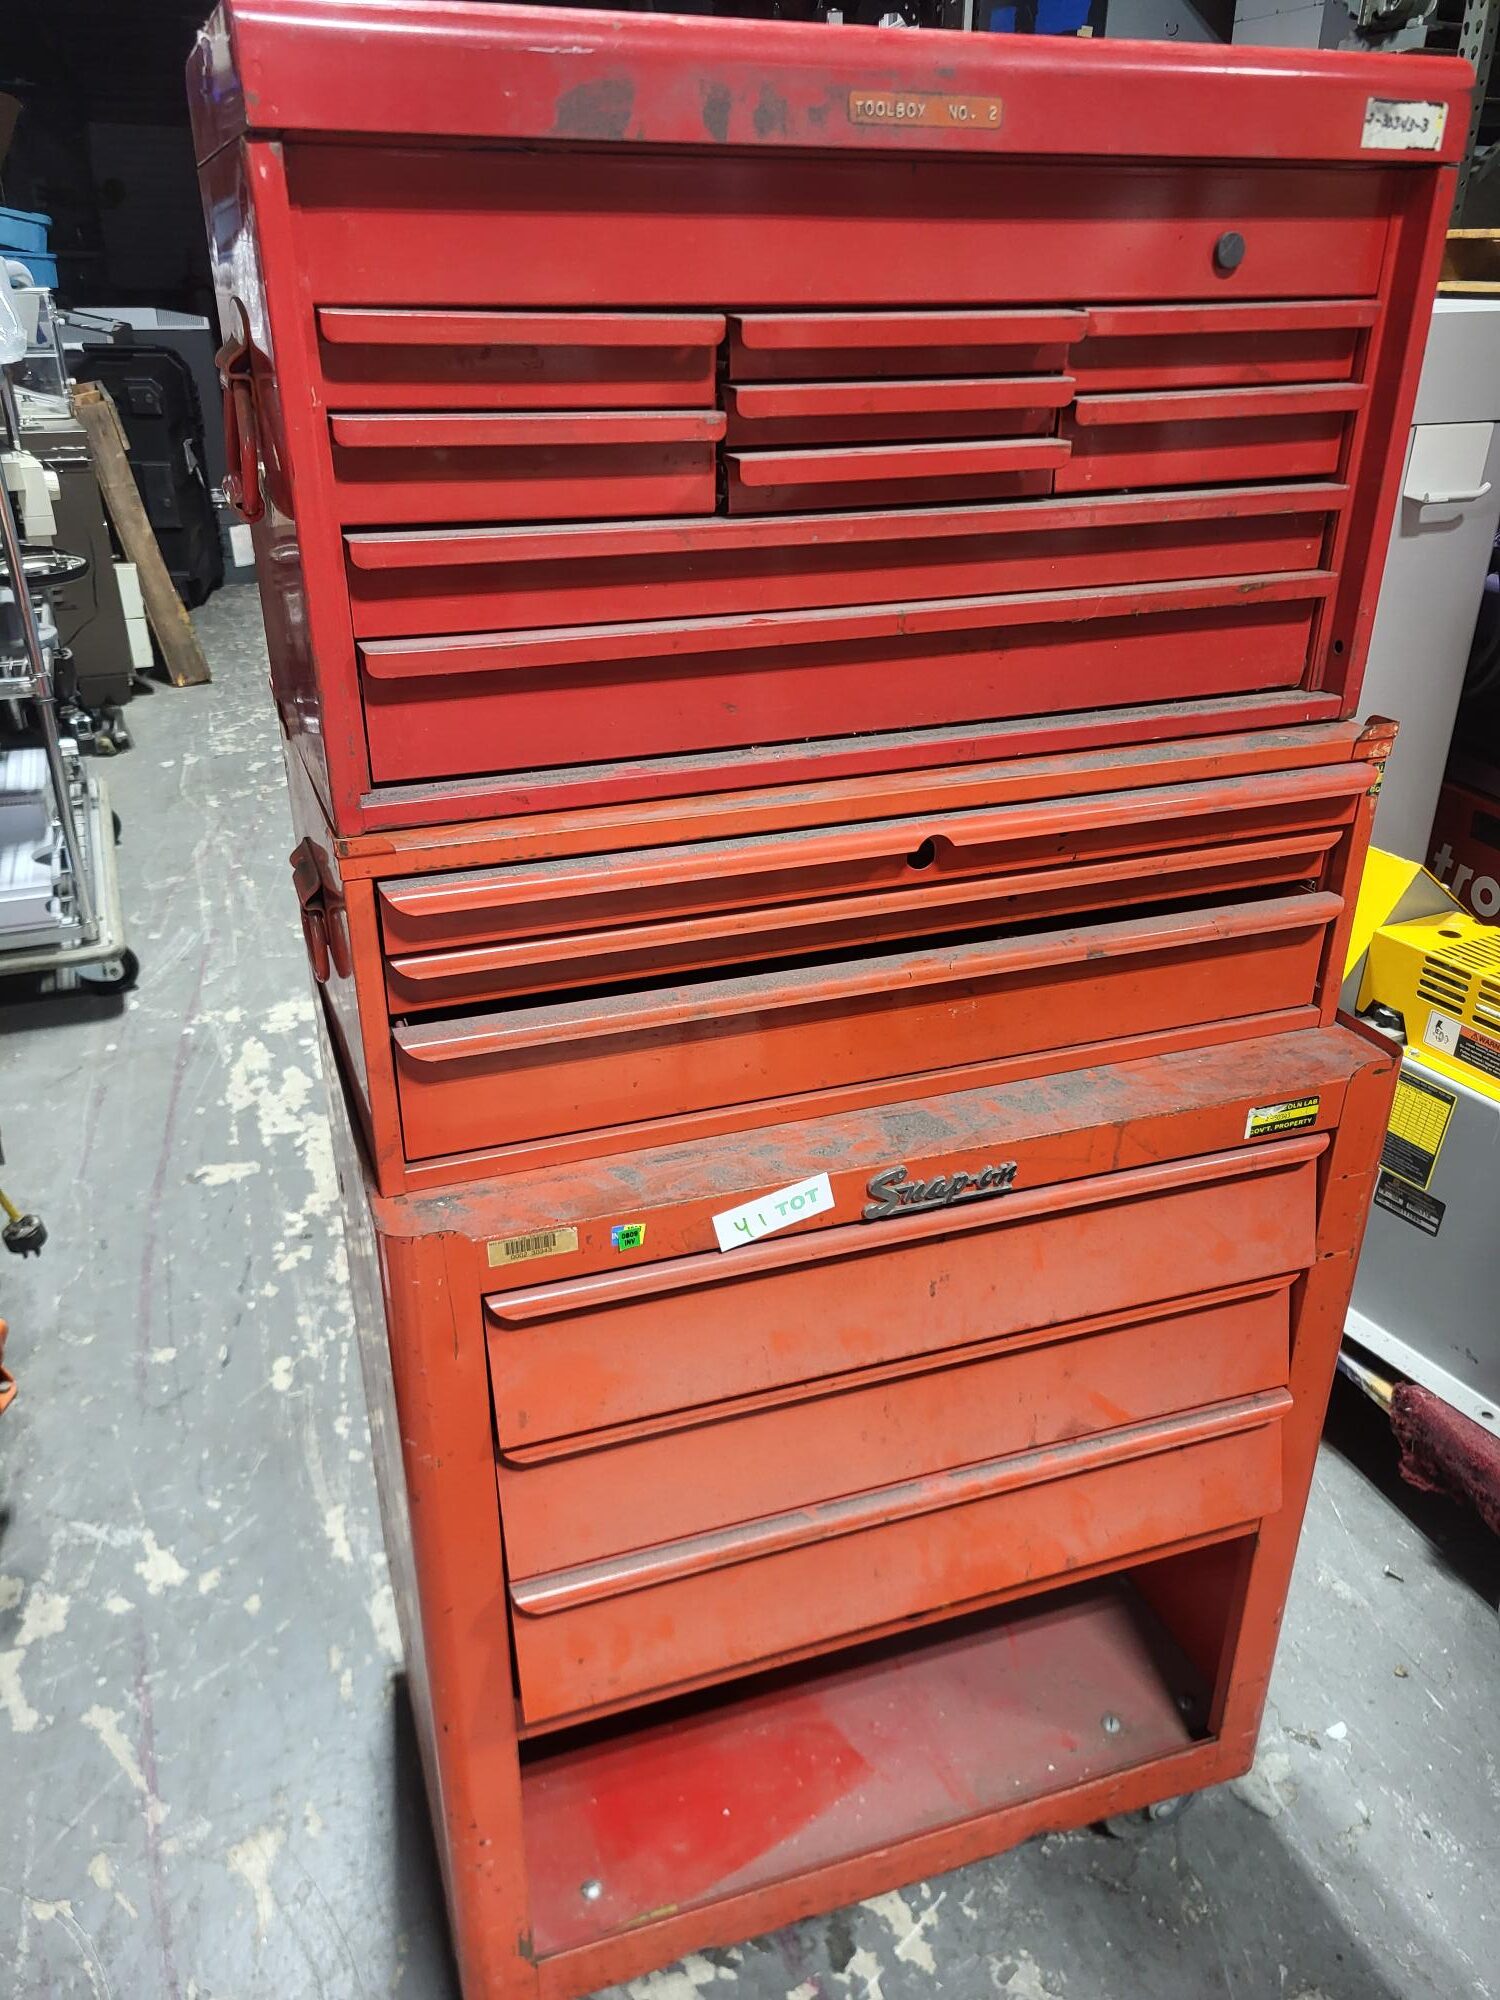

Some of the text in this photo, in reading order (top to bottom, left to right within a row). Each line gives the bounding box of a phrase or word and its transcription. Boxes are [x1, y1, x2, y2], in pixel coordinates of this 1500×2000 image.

[989, 105, 998, 121] 2
[1304, 1098, 1318, 1107] LAB
[1275, 1117, 1313, 1130] PROPERTY
[862, 1160, 1018, 1219] Snap-on
[774, 1187, 819, 1217] TOT
